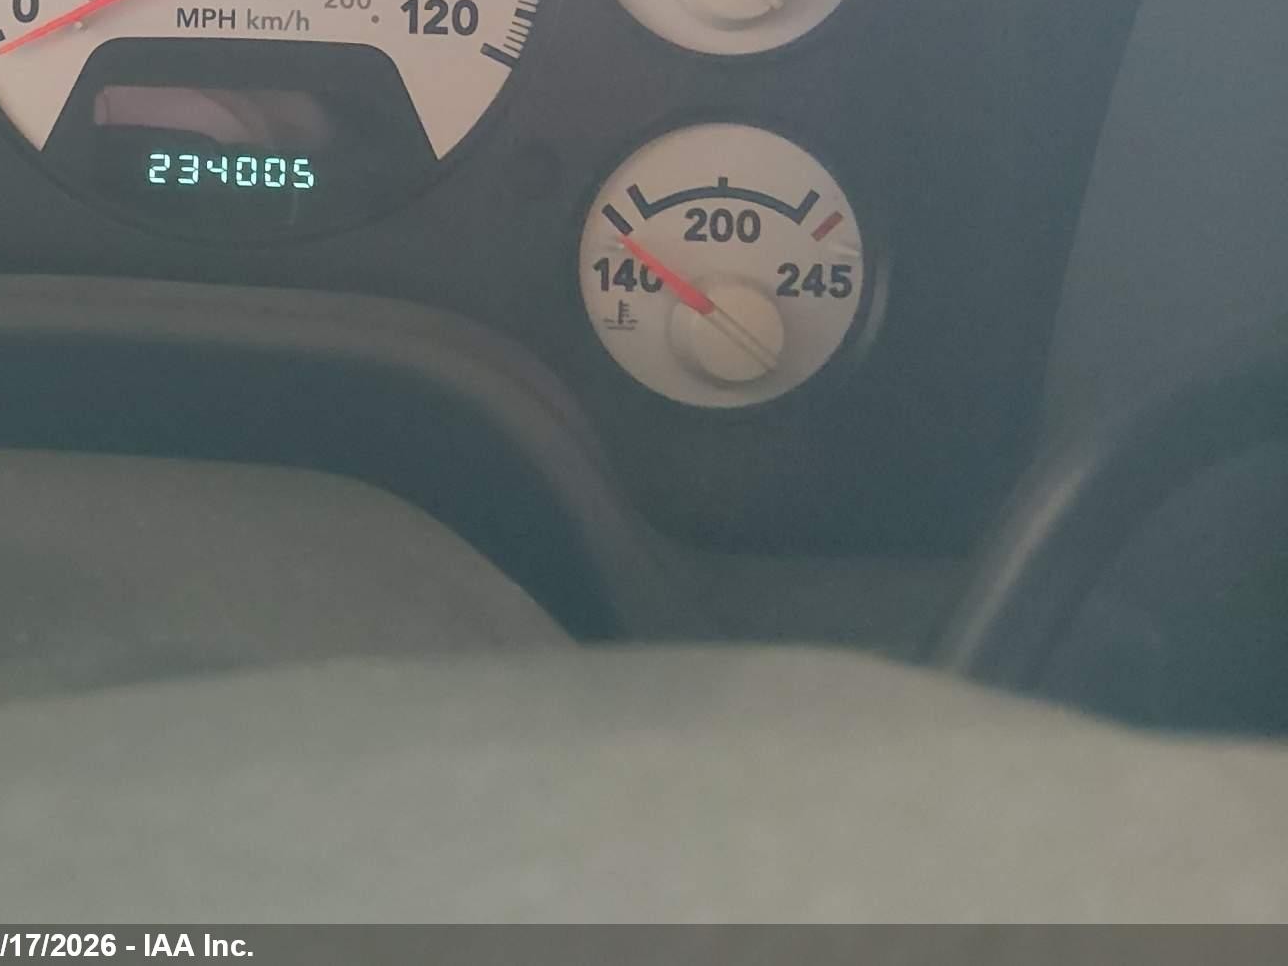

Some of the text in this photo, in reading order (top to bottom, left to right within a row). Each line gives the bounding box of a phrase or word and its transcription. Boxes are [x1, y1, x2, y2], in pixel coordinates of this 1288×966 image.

[176, 8, 311, 32] MPH km/h
[148, 153, 314, 189] 234005
[683, 207, 761, 245] 200
[593, 257, 664, 293] 140
[776, 263, 853, 299] 245
